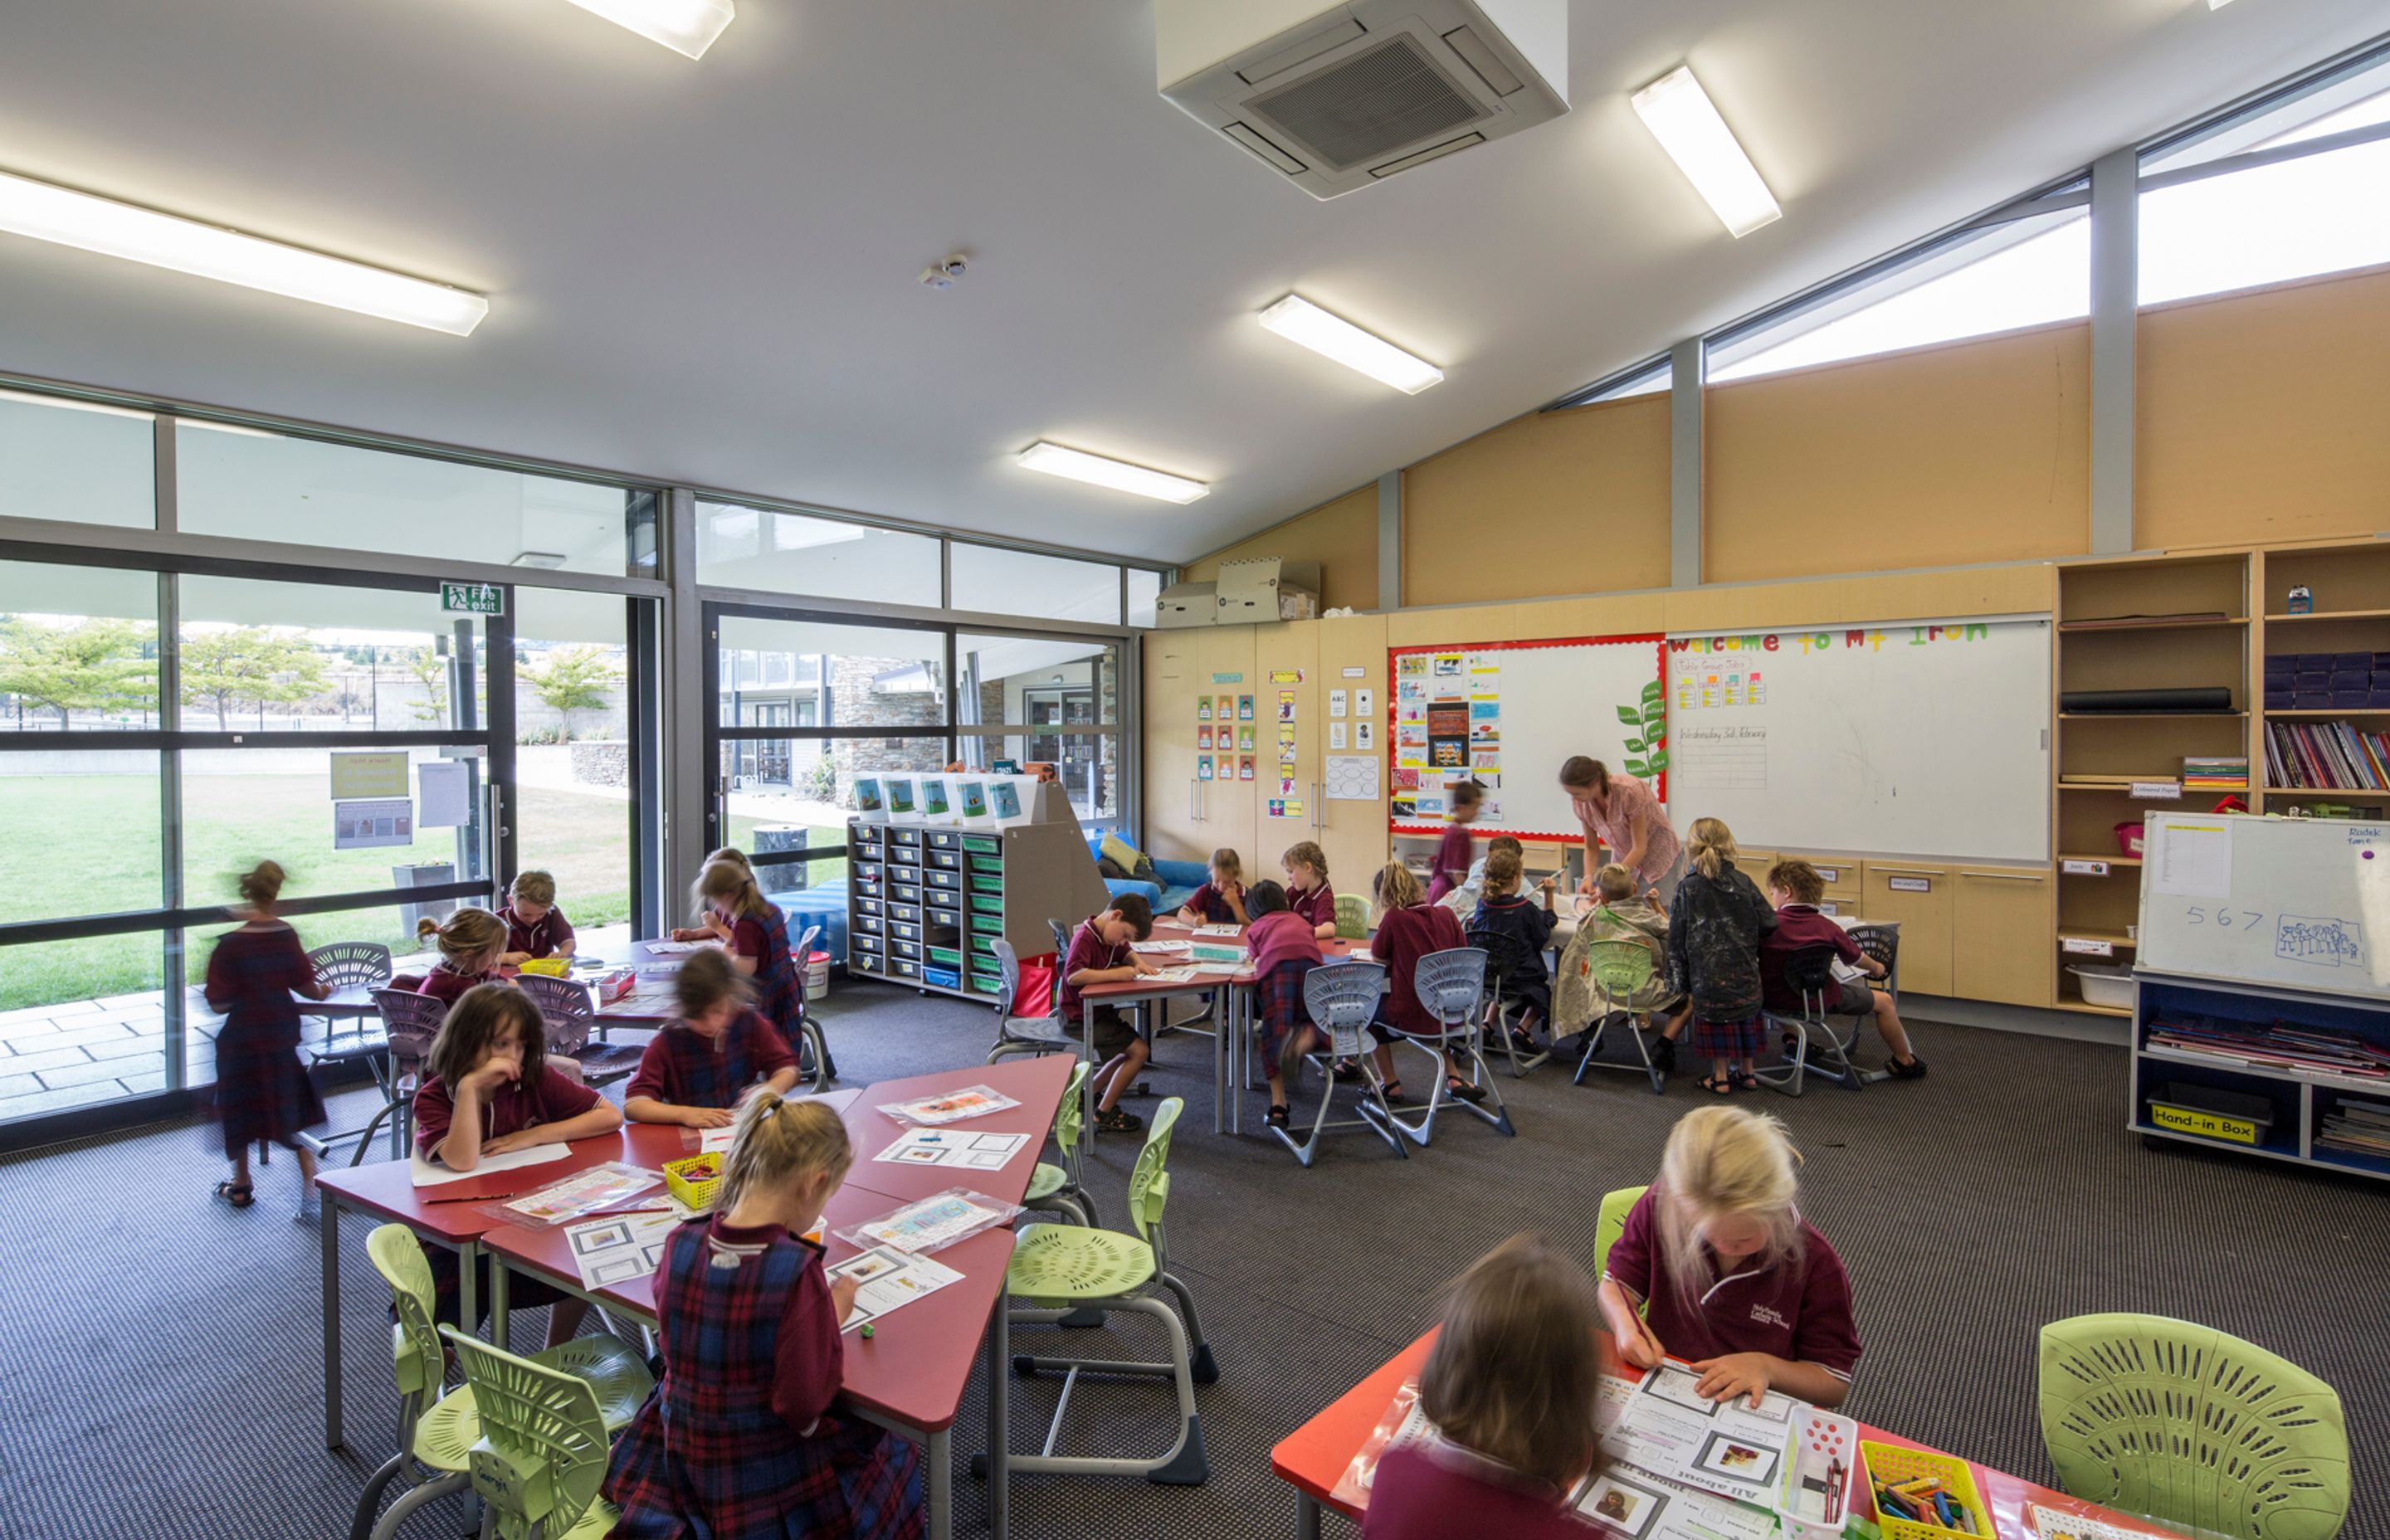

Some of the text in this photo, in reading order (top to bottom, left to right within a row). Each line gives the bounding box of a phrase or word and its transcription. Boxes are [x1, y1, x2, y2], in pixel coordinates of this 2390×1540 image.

[471, 601, 495, 612] exit
[1796, 631, 1831, 655] to
[1846, 629, 1885, 651] Mt
[1909, 624, 1988, 646] Iron
[2349, 827, 2381, 836] Radek
[2187, 906, 2263, 930] 5 6 7
[2155, 1109, 2251, 1137] Hand-in Box
[1678, 1470, 1758, 1499] All about
